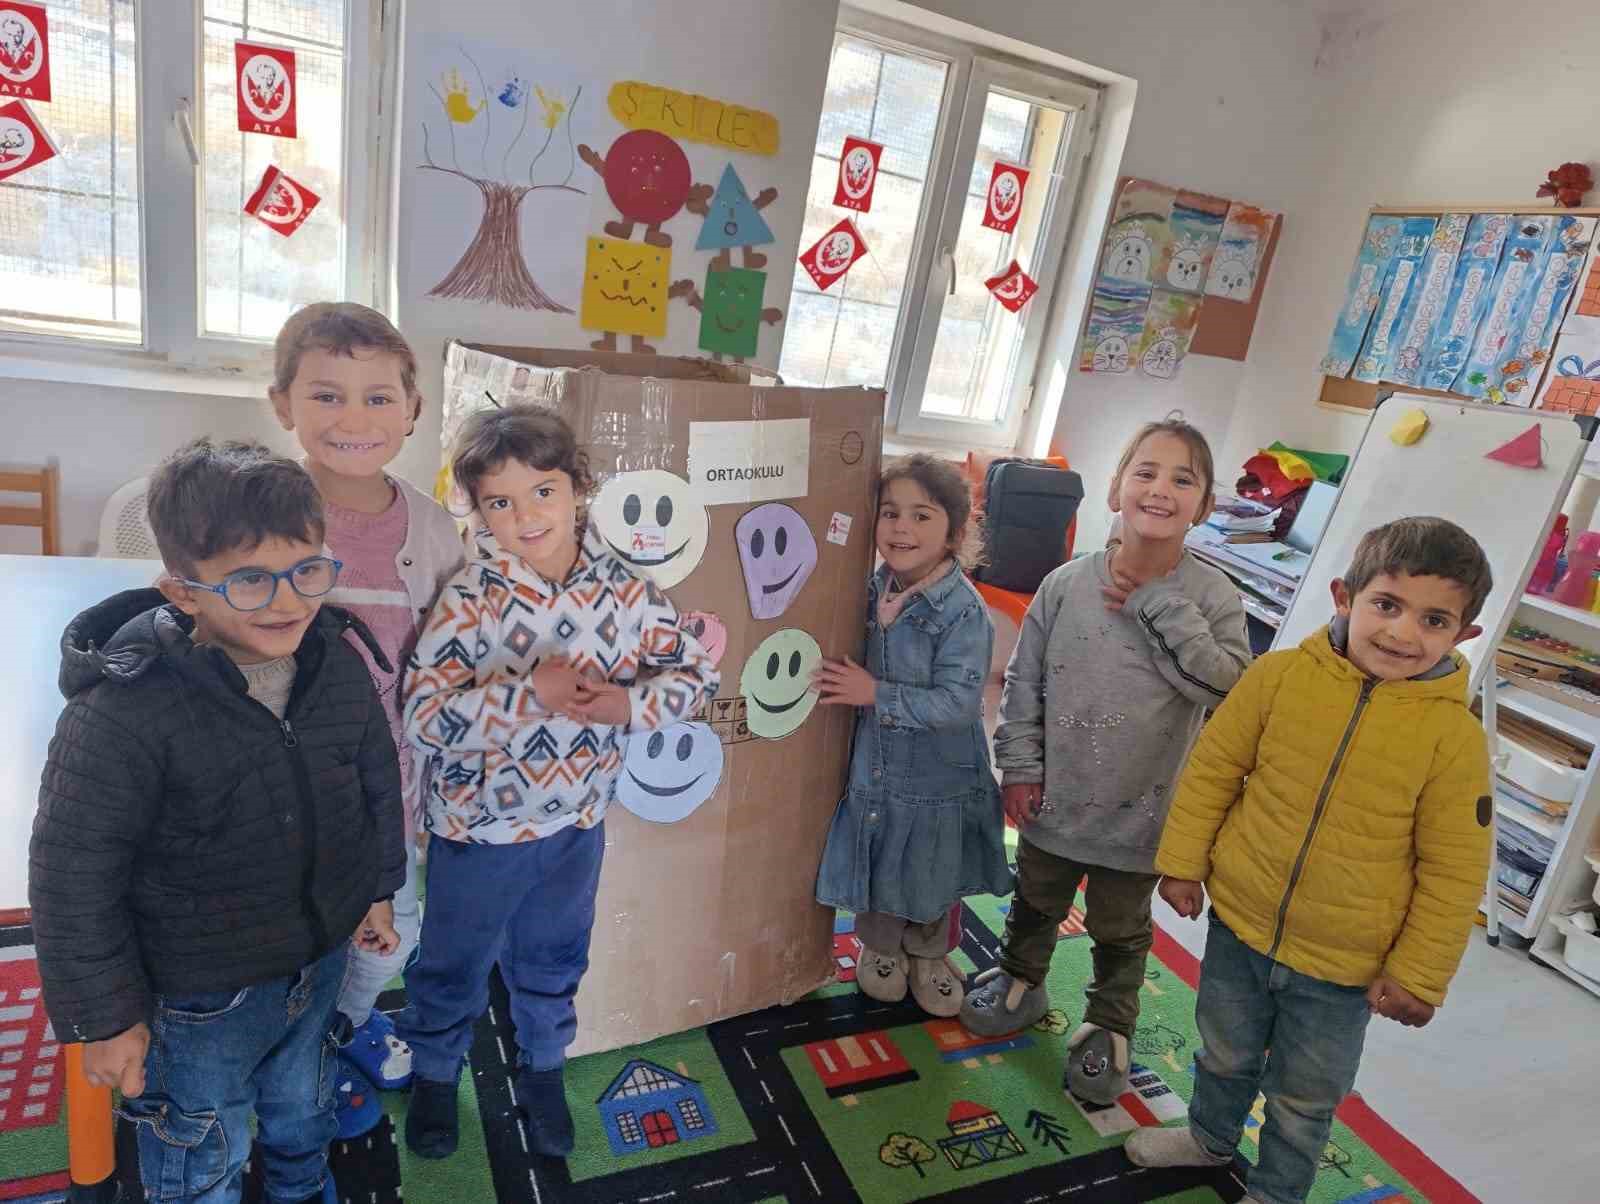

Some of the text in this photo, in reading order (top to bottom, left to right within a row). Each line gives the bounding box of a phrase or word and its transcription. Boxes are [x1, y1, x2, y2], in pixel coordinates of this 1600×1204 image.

[253, 123, 282, 134] ATA
[842, 199, 862, 209] ATA
[990, 222, 1006, 230] ATA
[706, 464, 784, 482] ORTAOKULU
